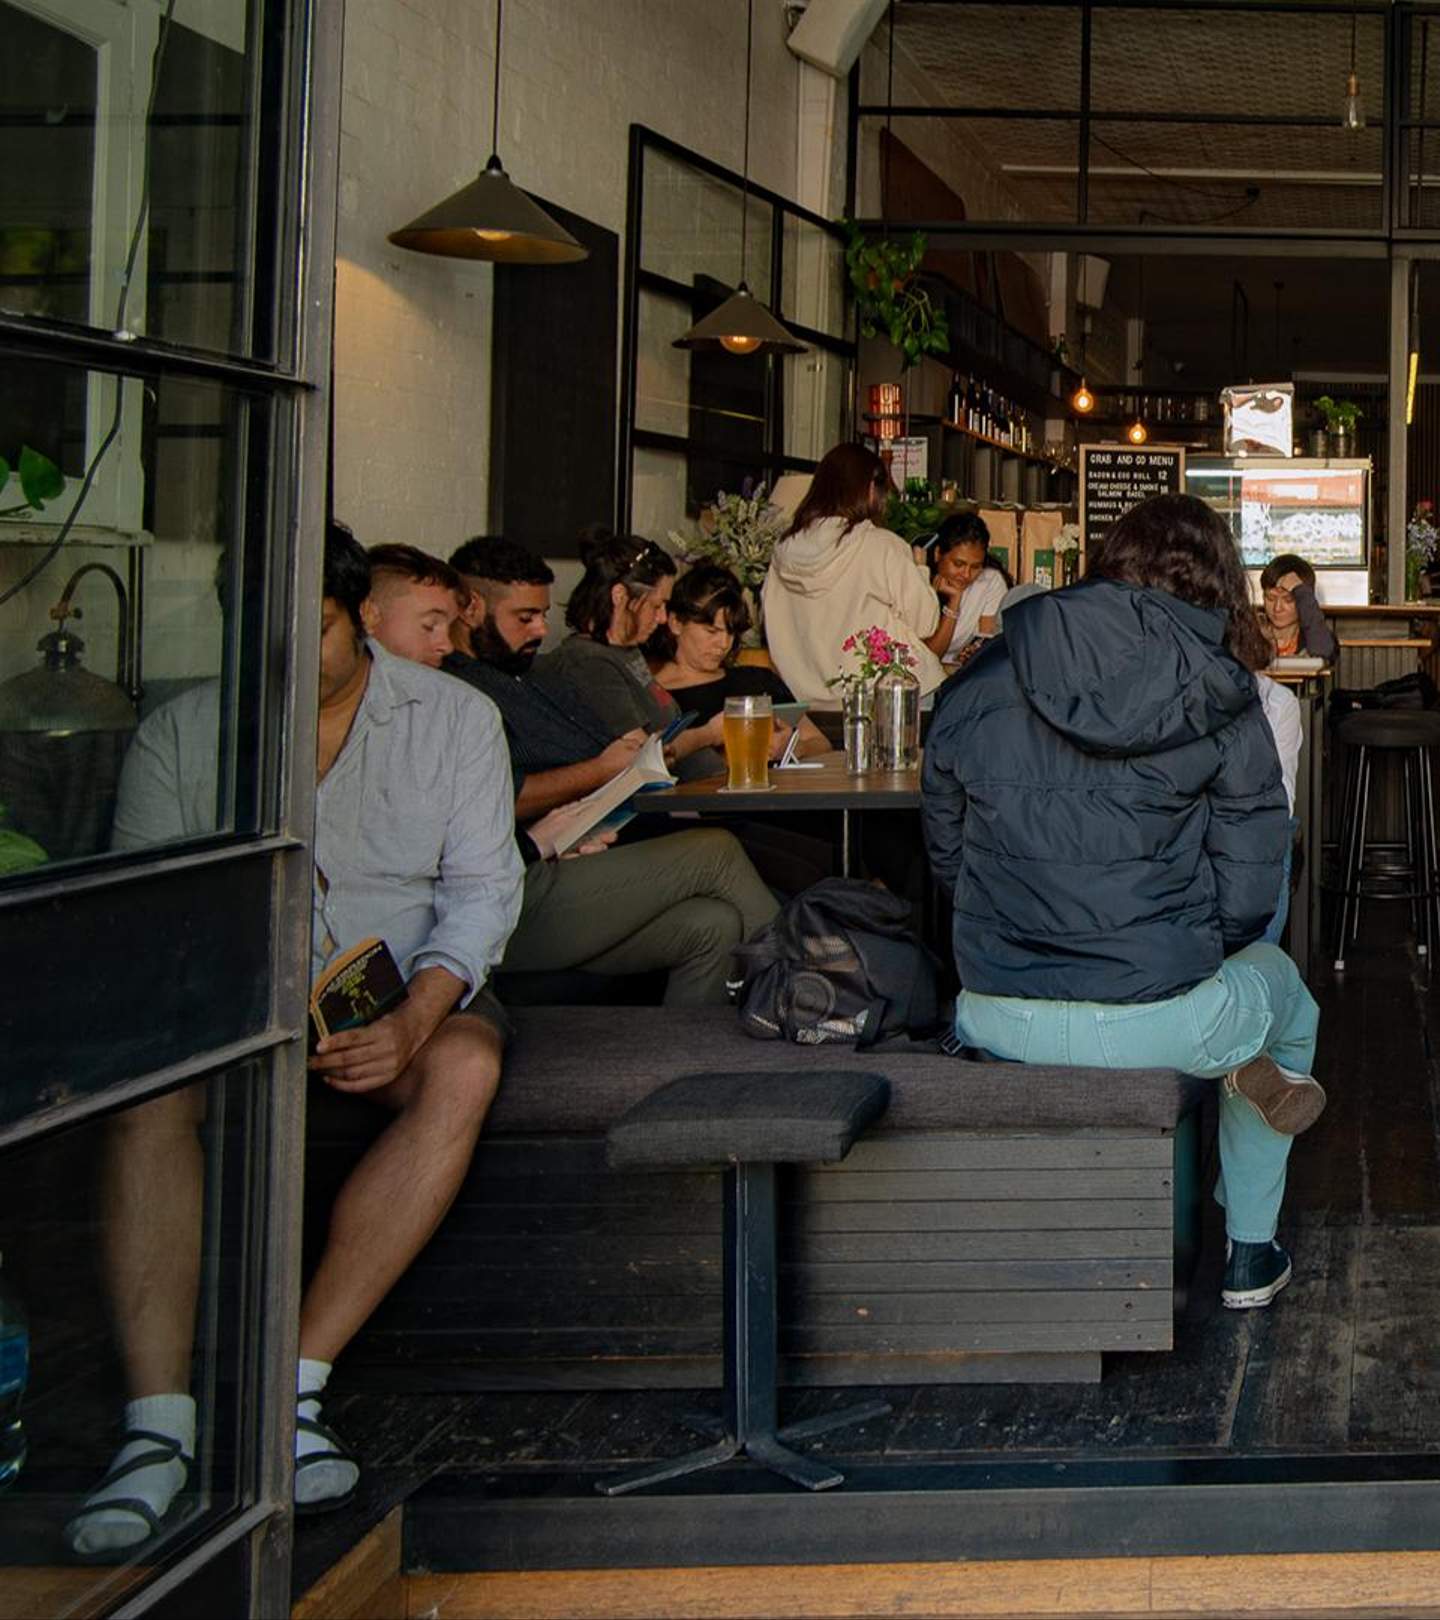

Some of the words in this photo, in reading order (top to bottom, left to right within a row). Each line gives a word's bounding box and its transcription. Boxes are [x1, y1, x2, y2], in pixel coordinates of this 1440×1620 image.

[1090, 454, 1112, 464] GRAB
[1117, 456, 1133, 465] AND
[1135, 456, 1146, 465] GO
[1149, 456, 1174, 466] MENU
[1158, 470, 1168, 480] 12
